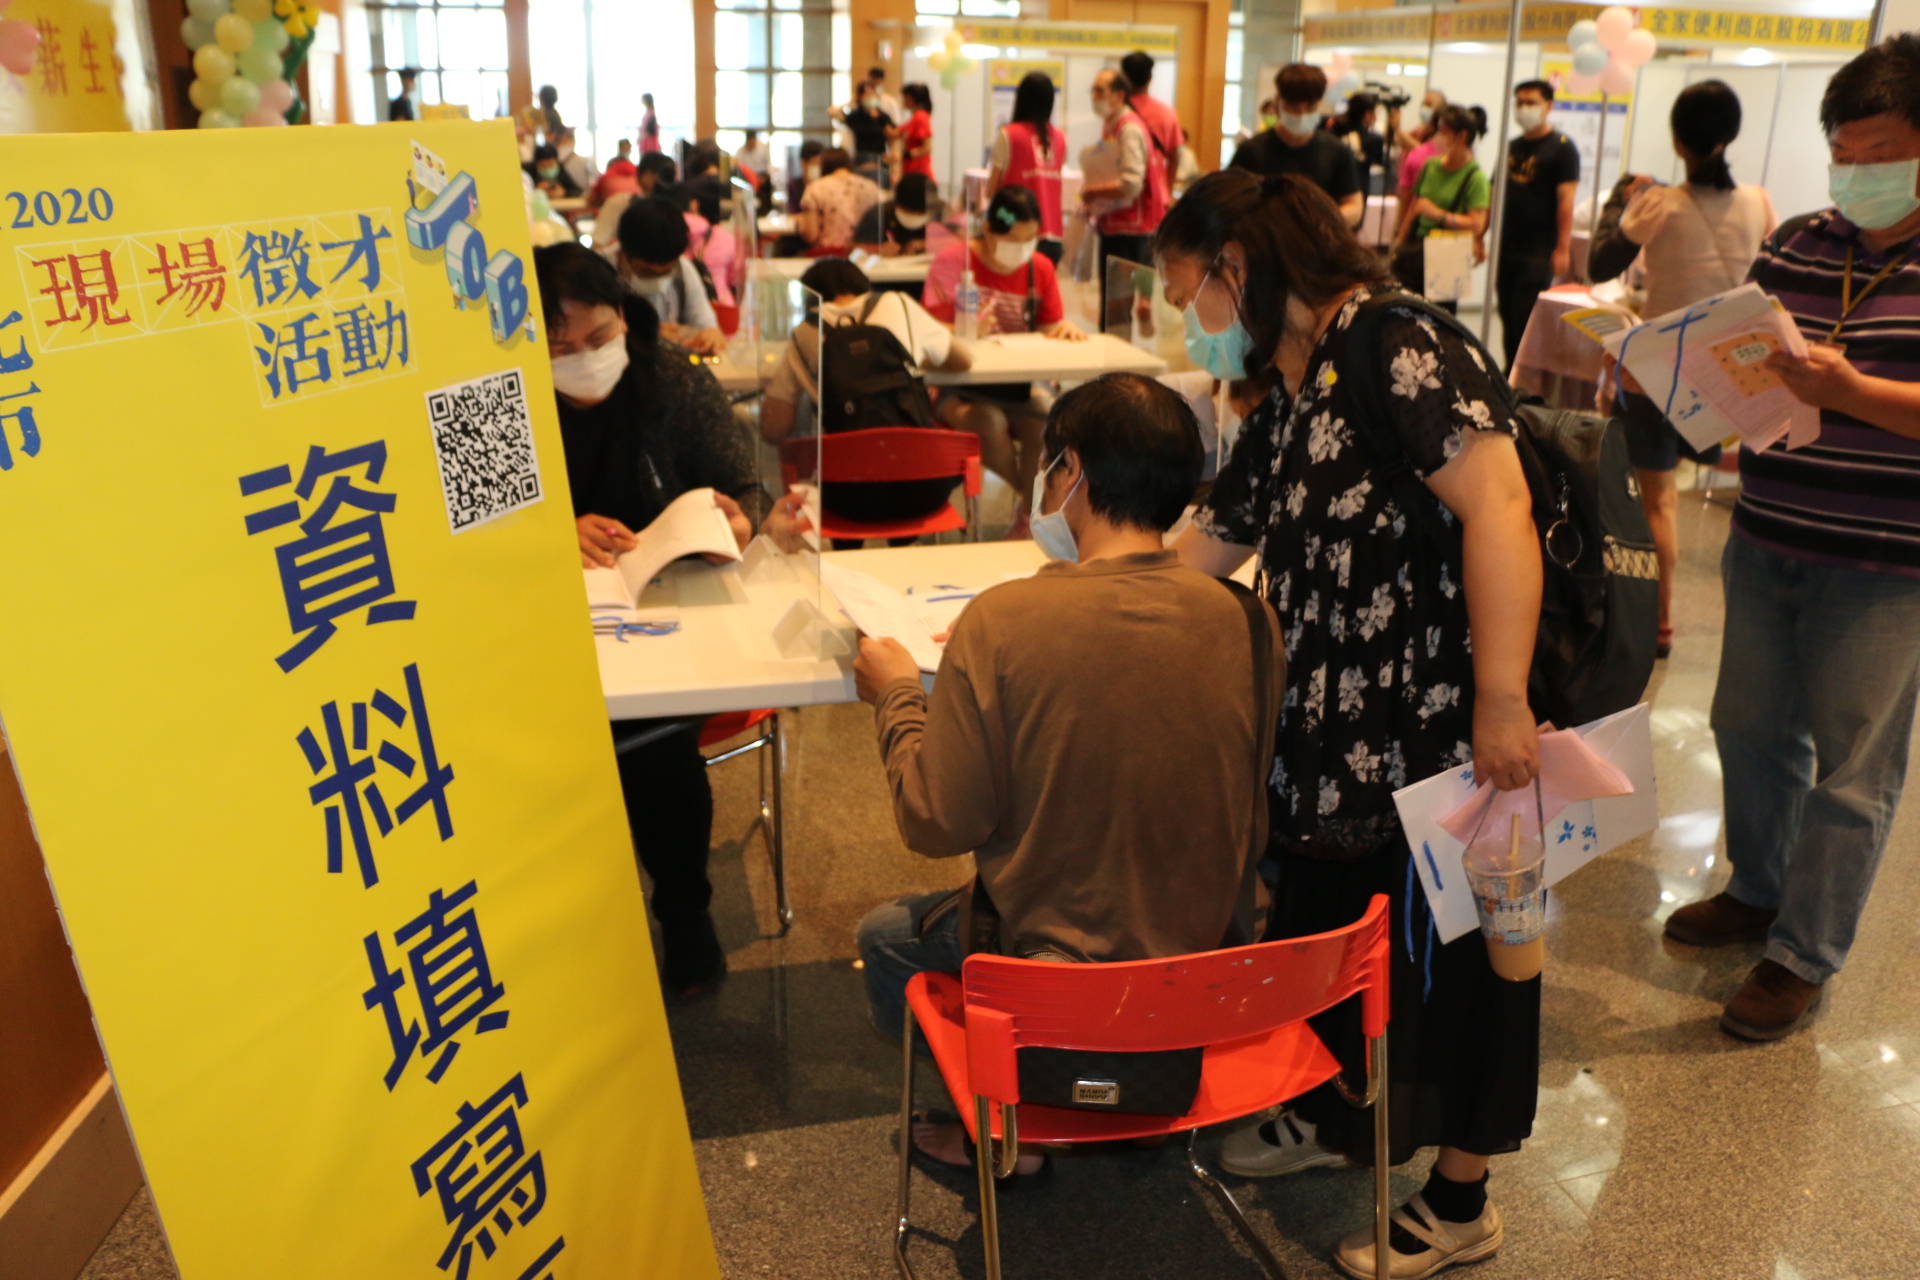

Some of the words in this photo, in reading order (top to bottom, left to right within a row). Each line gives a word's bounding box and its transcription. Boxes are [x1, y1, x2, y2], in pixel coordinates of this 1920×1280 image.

[5, 187, 113, 229] 2020
[404, 170, 528, 340] JOB
[31, 214, 392, 333] 現場徵才
[254, 299, 409, 399] 活動
[239, 440, 565, 1280] 資料填寫
